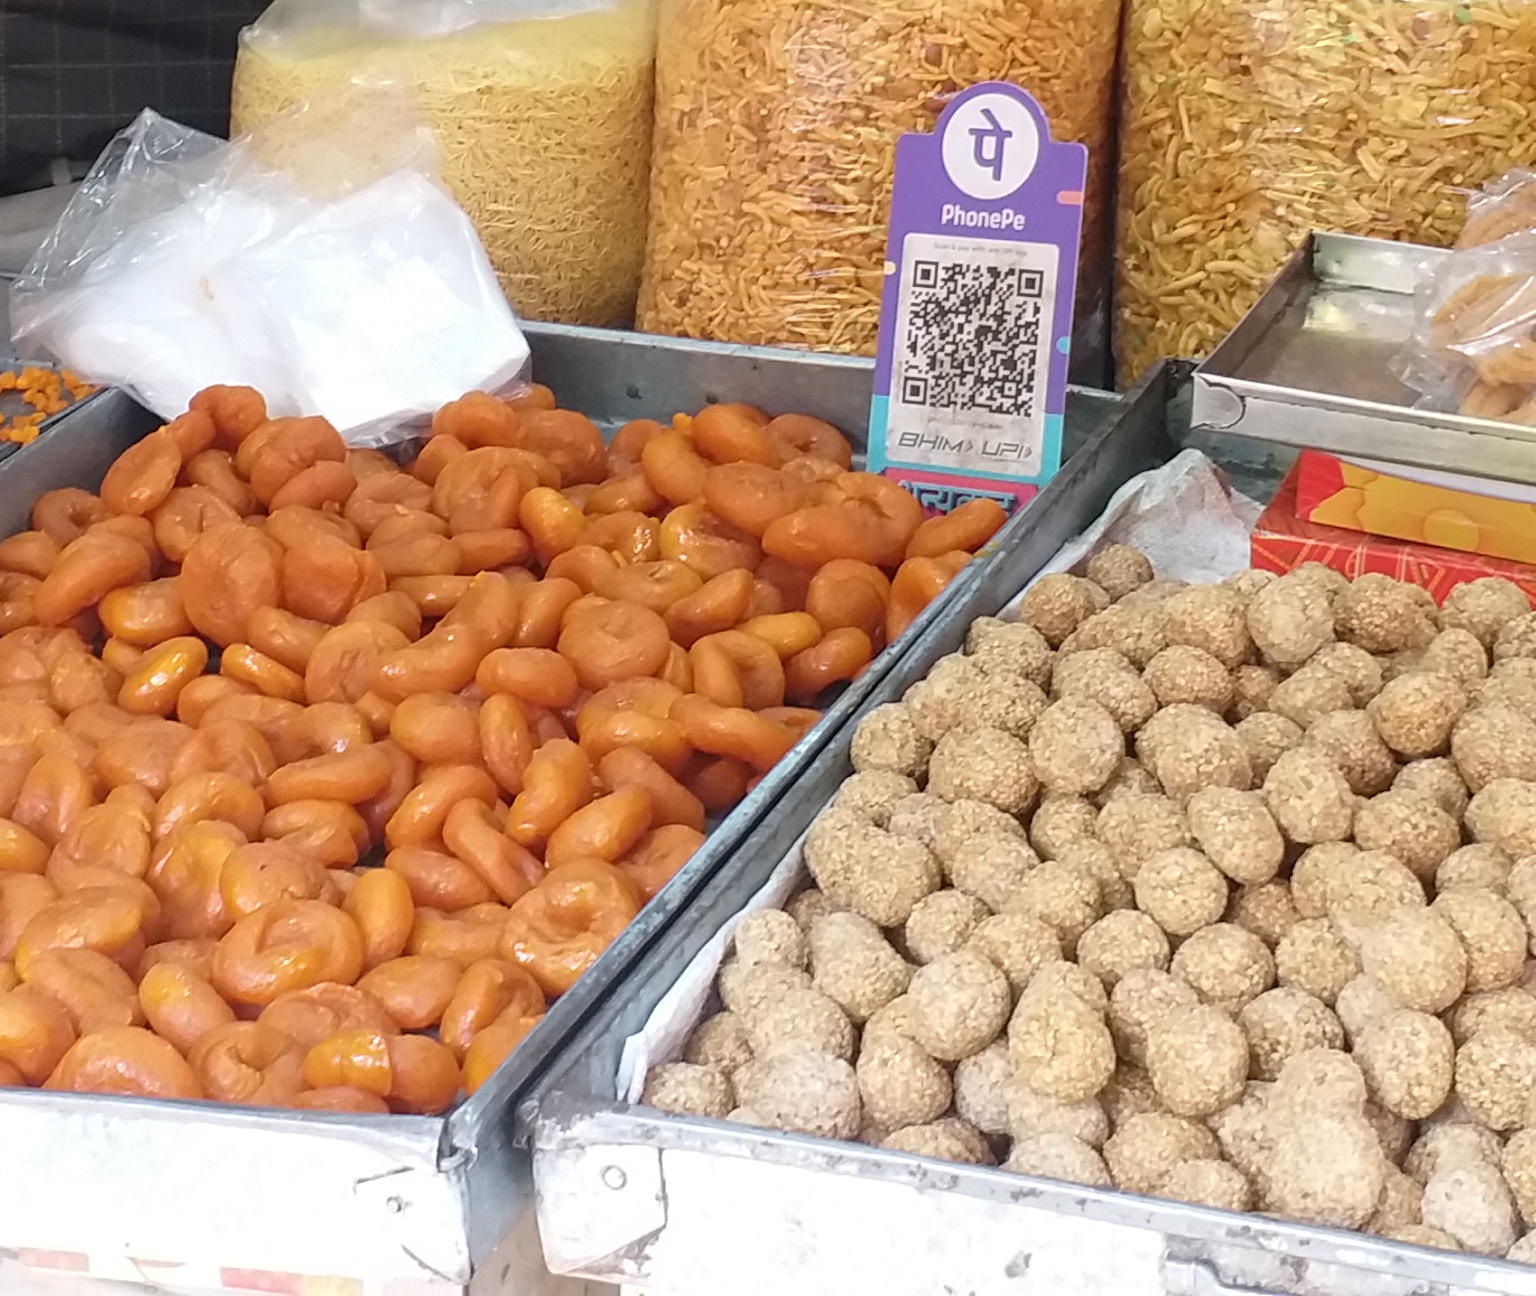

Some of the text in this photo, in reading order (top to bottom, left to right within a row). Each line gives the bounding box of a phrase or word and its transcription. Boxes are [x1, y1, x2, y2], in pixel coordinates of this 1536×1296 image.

[968, 107, 1013, 182] पे
[941, 203, 1025, 231] PhonePe
[898, 431, 1024, 459] BHIM UPI
